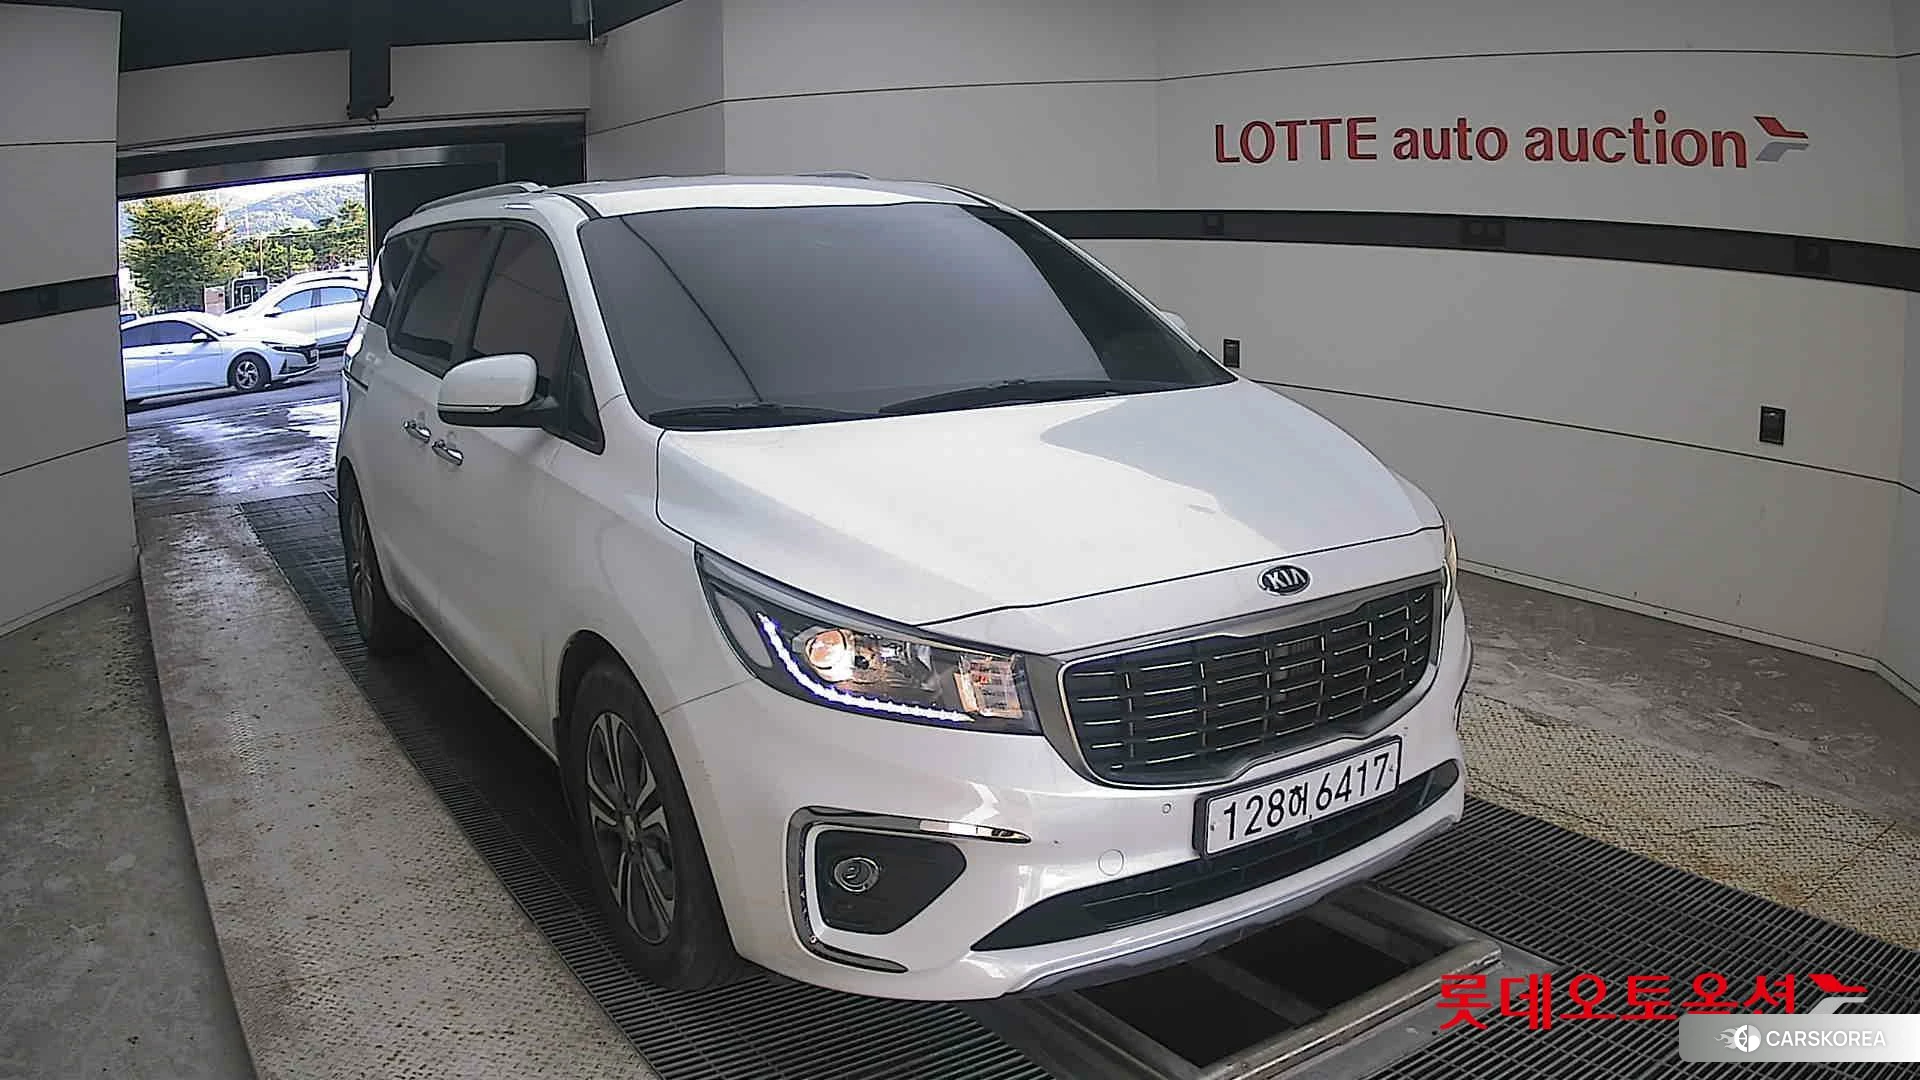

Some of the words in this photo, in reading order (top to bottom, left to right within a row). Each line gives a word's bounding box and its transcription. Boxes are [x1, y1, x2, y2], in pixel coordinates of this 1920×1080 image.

[1215, 116, 1378, 164] LOTTE
[1393, 117, 1509, 162] auto
[1524, 109, 1748, 169] auction
[1265, 568, 1306, 590] KIA
